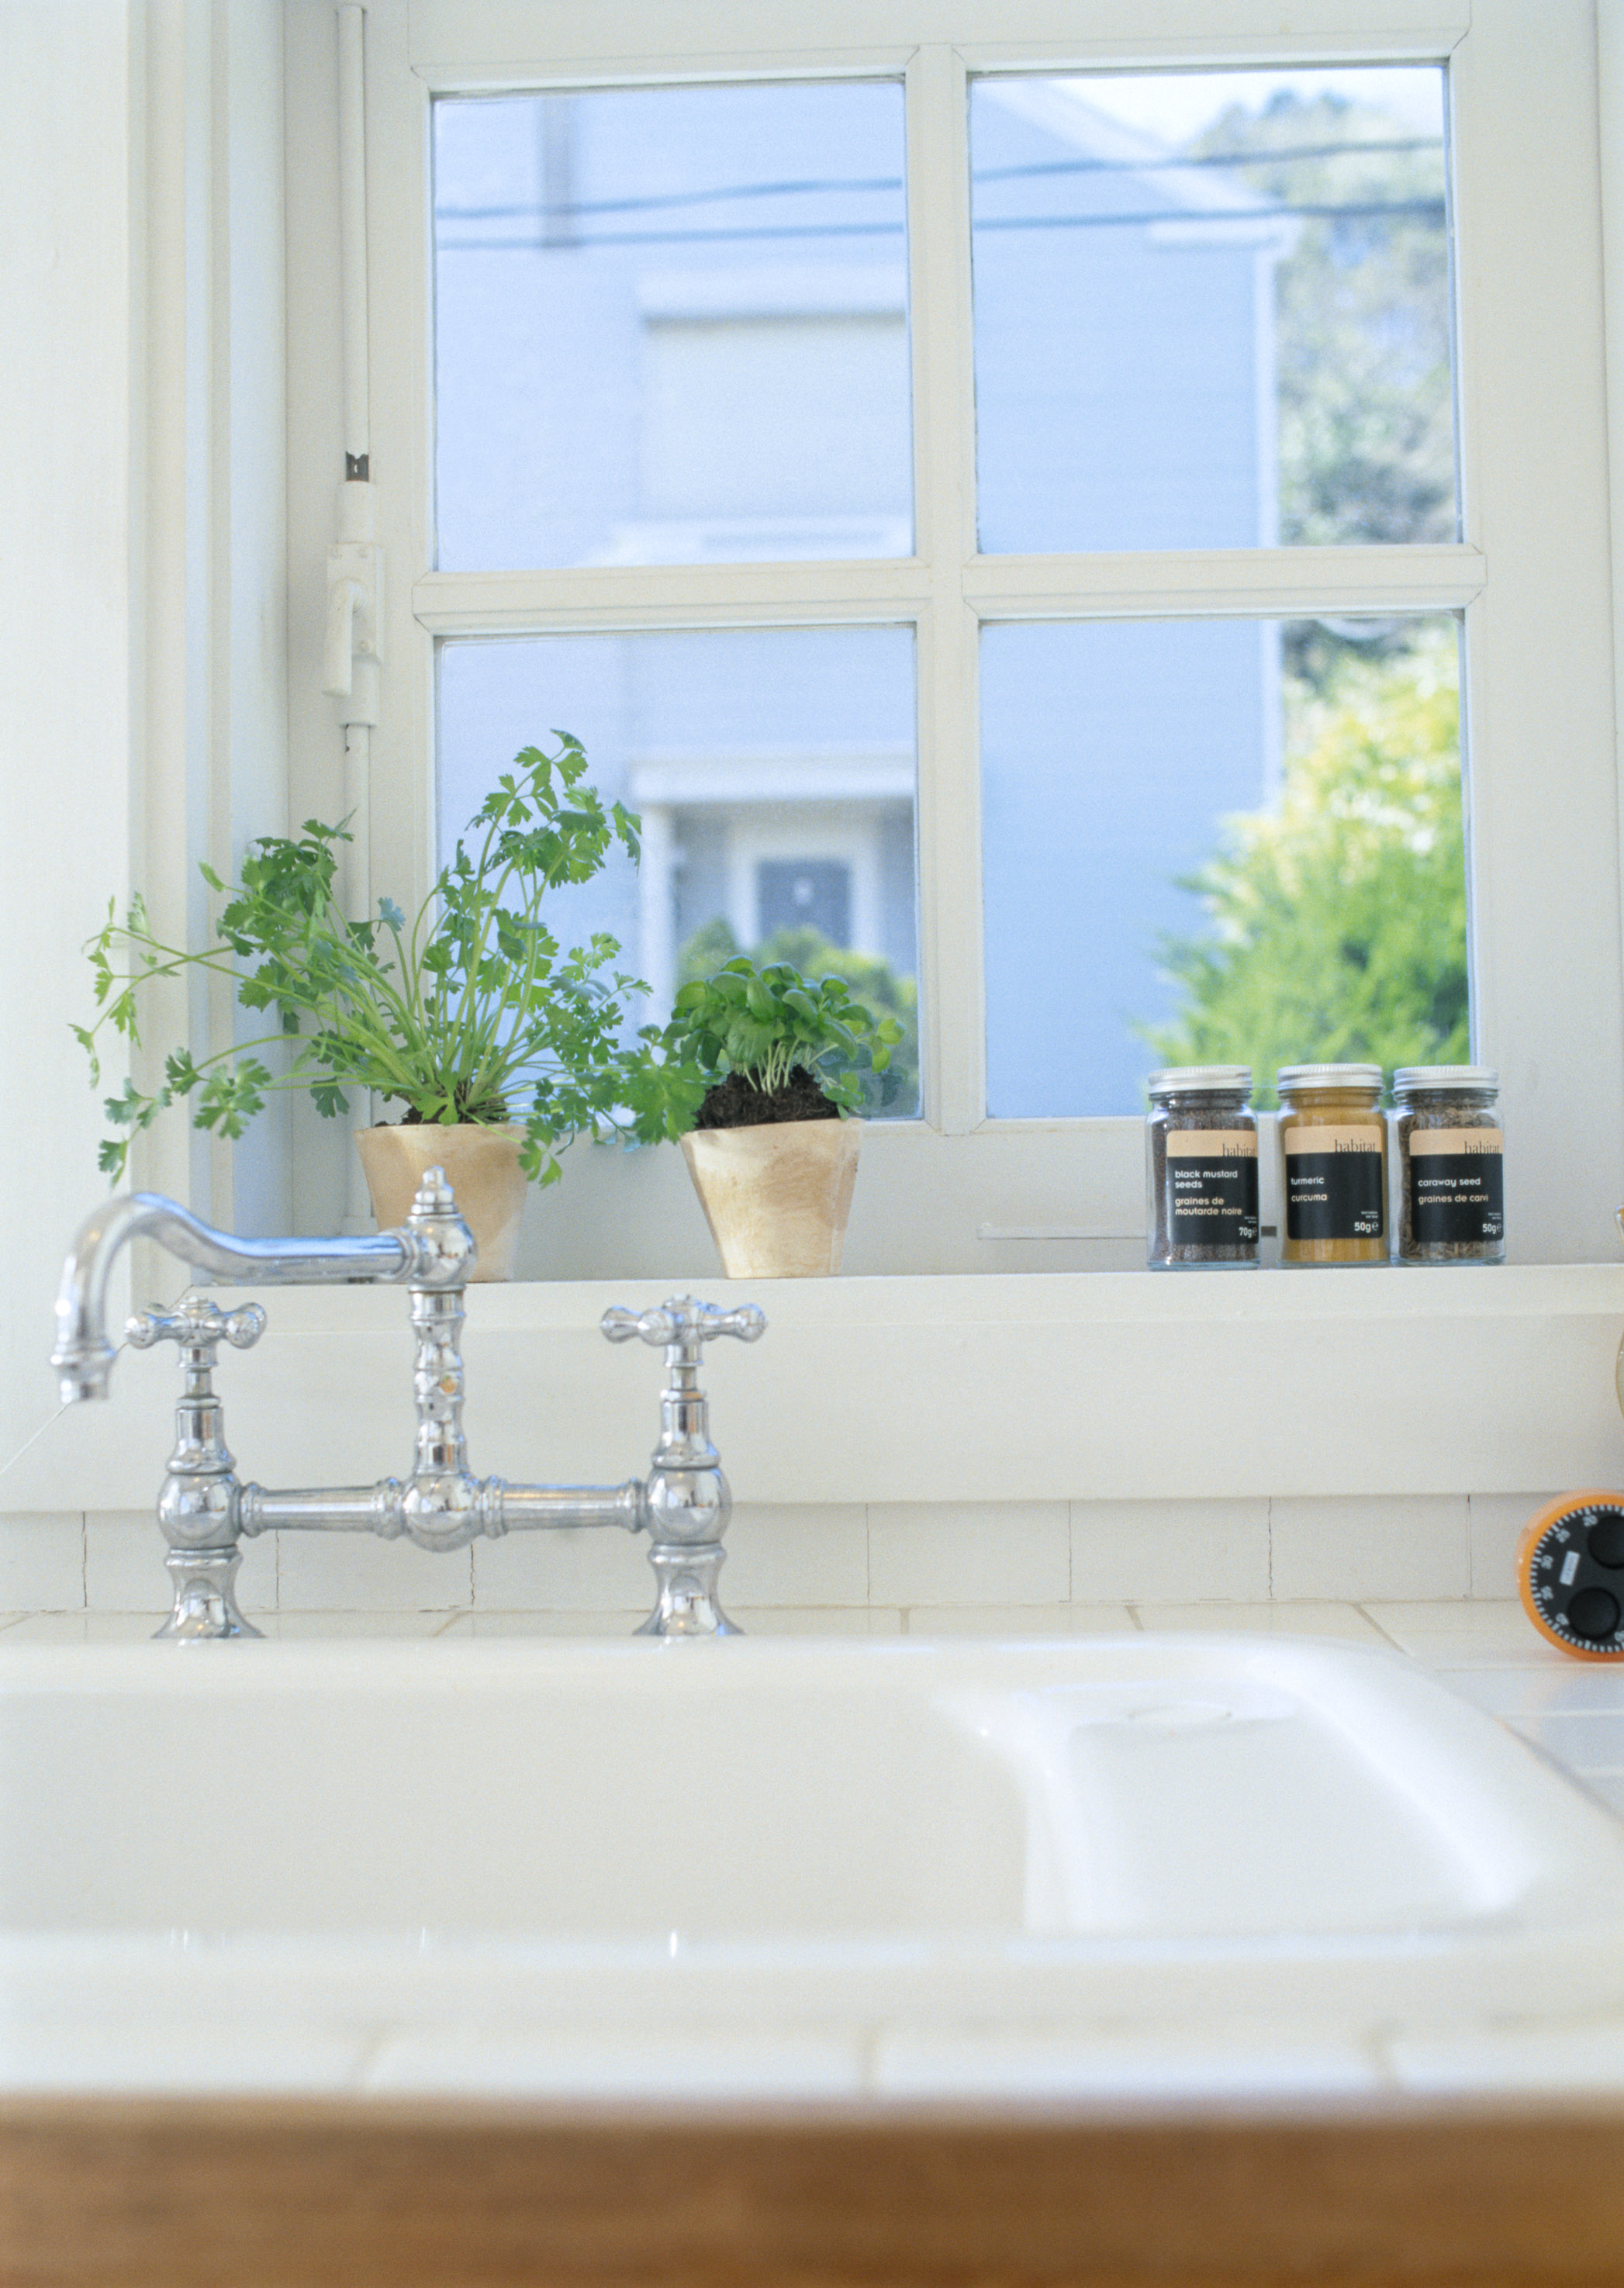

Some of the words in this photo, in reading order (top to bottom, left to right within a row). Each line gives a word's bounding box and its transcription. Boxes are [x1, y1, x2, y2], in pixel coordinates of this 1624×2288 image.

[1175, 1170, 1200, 1178] black
[1203, 1170, 1238, 1178] mustard
[1291, 1177, 1325, 1185] turmeric
[1418, 1179, 1456, 1187] caraway
[1459, 1177, 1481, 1186] seed
[1175, 1197, 1209, 1207] graines
[1211, 1197, 1225, 1205] de
[1291, 1194, 1328, 1202] curcuma
[1418, 1194, 1452, 1205] graines
[1470, 1194, 1488, 1202] carvi
[1175, 1207, 1219, 1215] moutarde
[1221, 1207, 1242, 1215] noire
